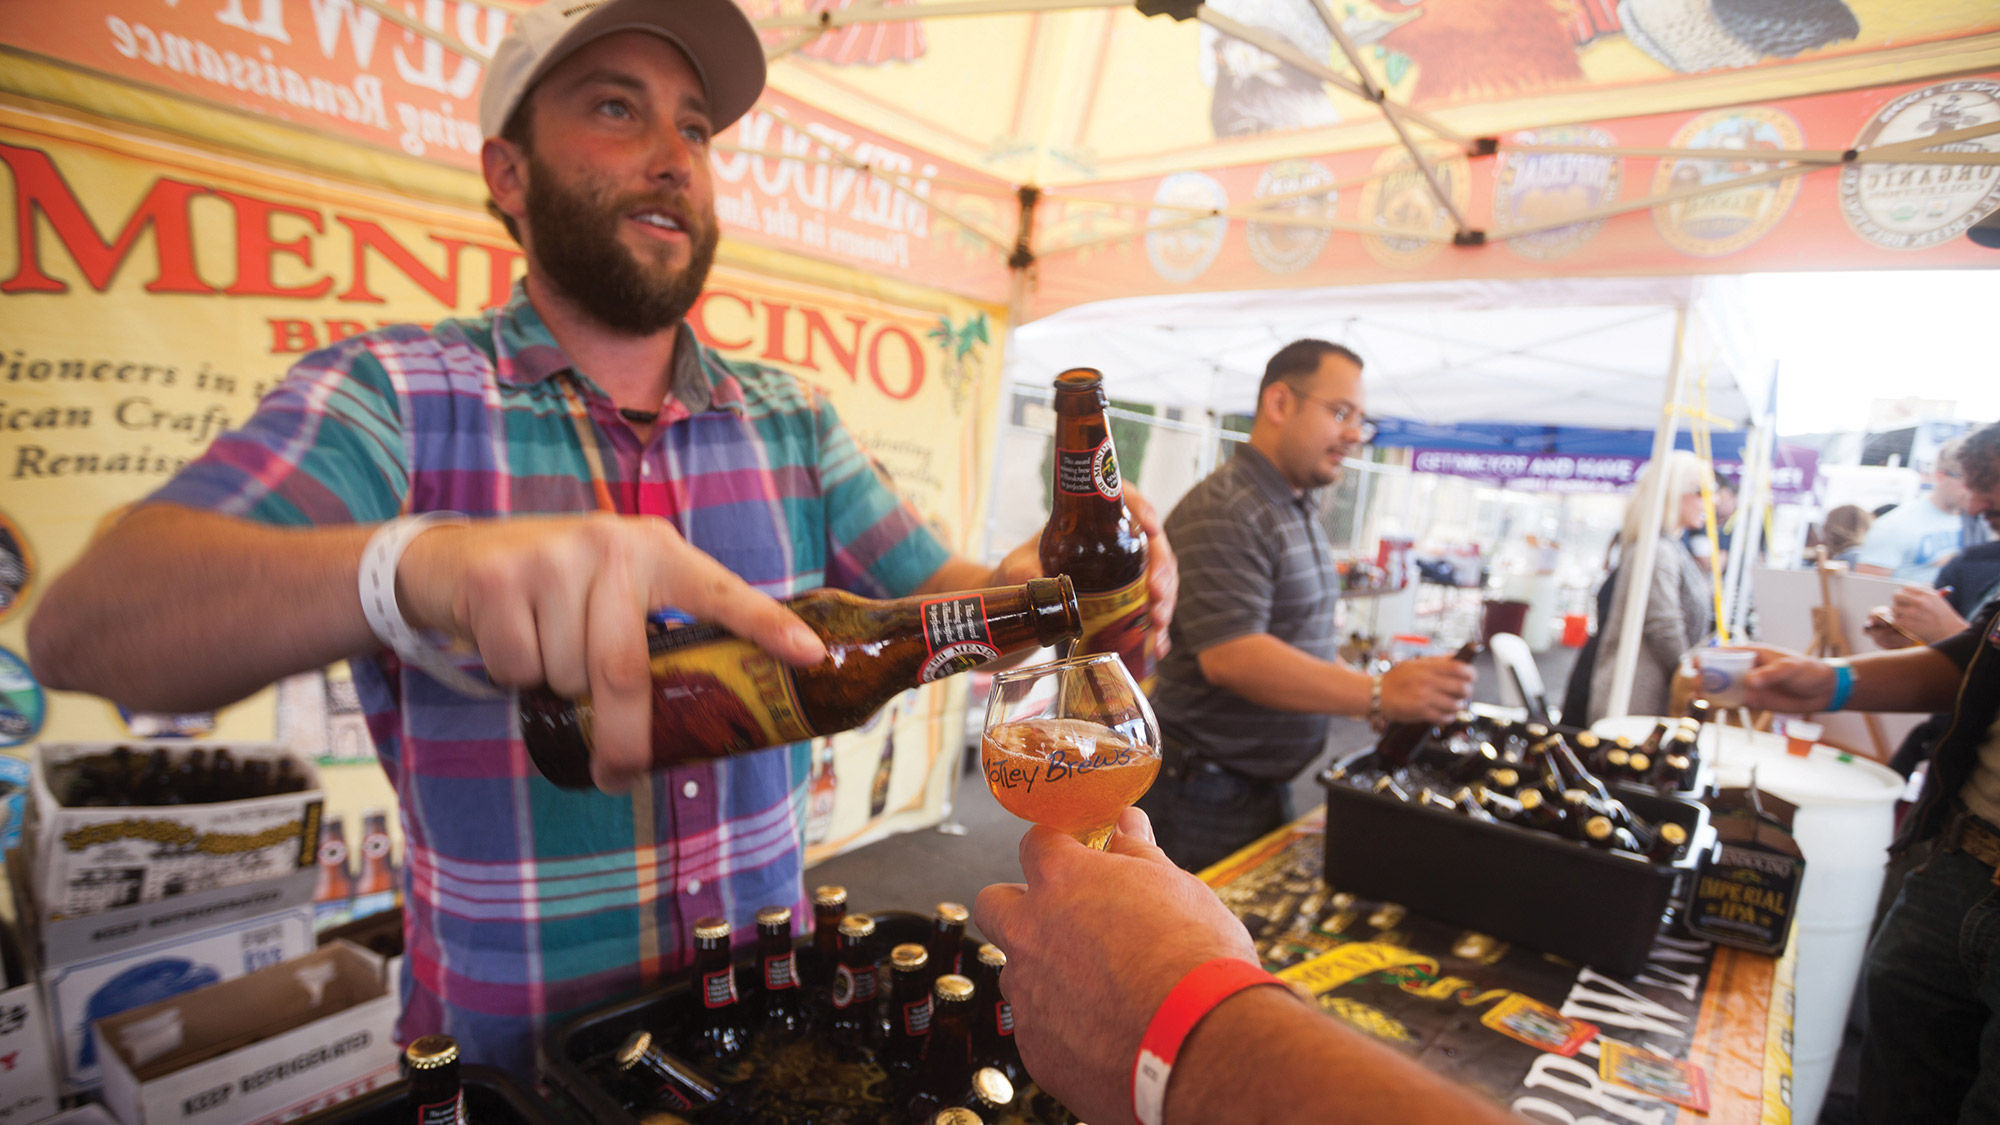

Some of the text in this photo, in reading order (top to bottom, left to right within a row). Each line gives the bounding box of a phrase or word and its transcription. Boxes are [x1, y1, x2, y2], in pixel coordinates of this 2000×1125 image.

[0, 348, 177, 388] ioneers
[196, 362, 236, 394] in
[1045, 748, 1131, 782] Brews
[1699, 876, 1785, 916] IMPERIAL
[1721, 901, 1757, 923] IPA
[182, 1083, 233, 1116] KEEP
[240, 1029, 371, 1093] REFRIGERATED
